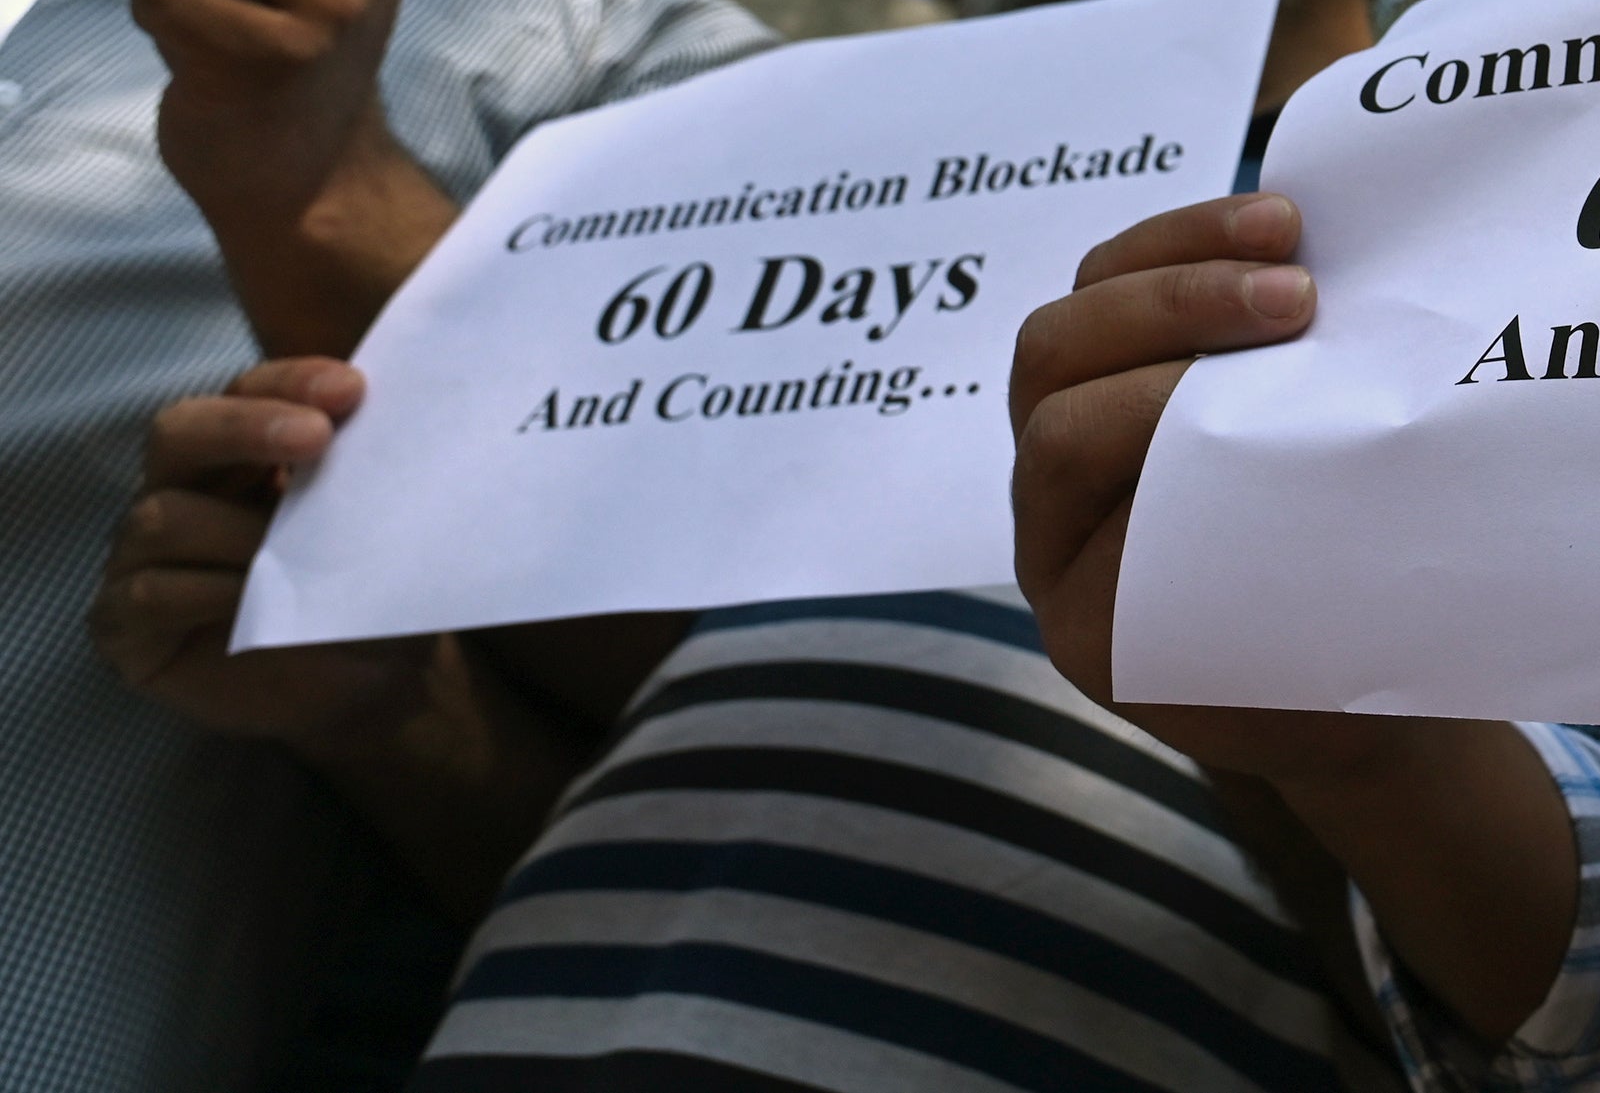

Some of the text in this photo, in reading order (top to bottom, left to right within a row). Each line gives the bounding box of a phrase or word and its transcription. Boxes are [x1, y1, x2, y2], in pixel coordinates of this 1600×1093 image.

[505, 134, 1184, 255] Communication Blockade
[594, 250, 986, 346] 60 Days
[516, 359, 981, 434] And Counting...
